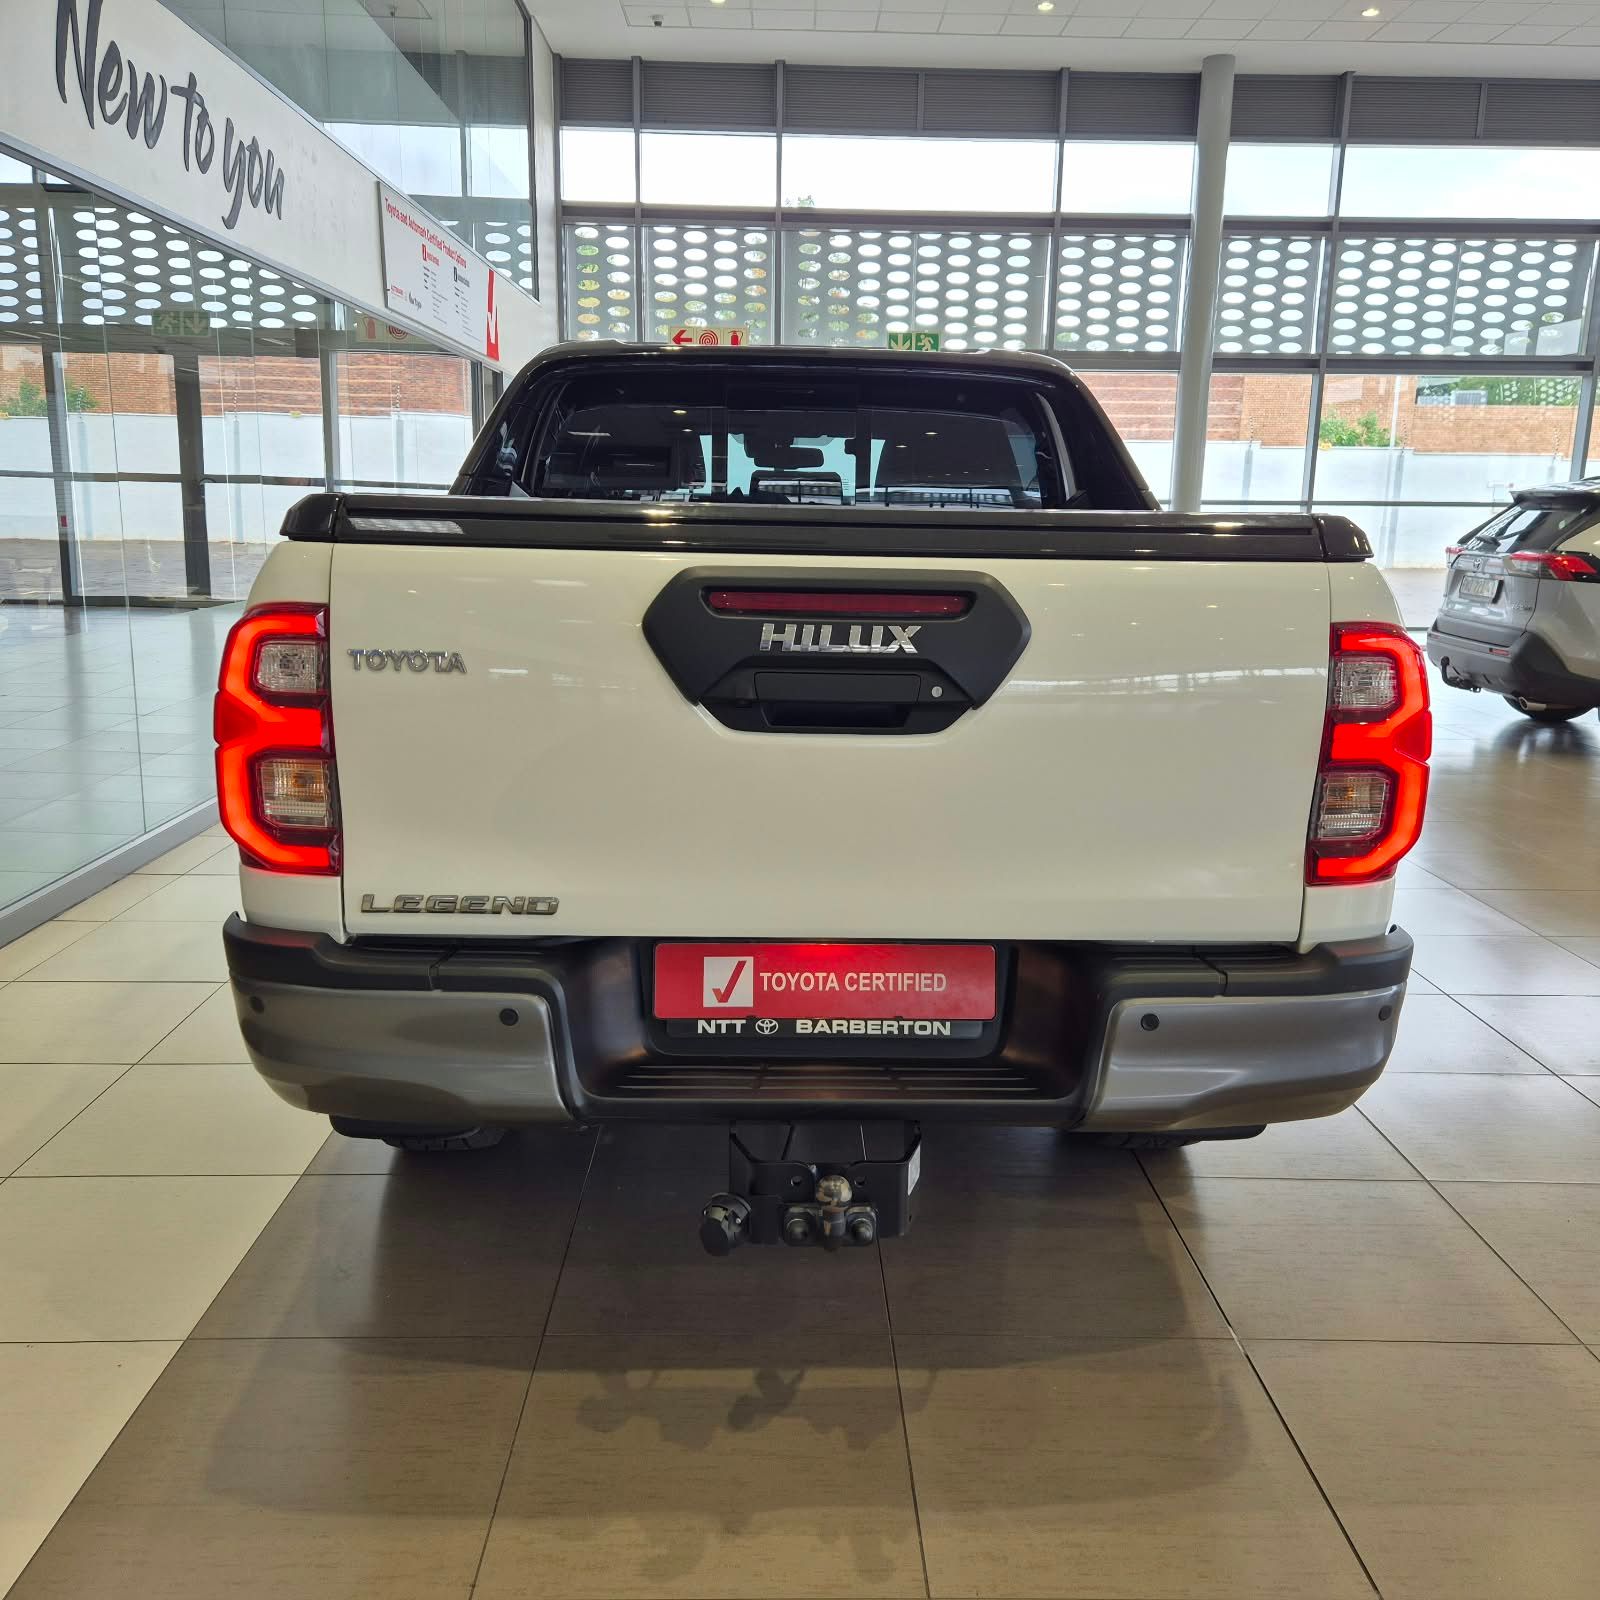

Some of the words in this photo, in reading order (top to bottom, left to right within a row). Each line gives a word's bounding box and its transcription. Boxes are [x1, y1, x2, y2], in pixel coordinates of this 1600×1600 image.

[56, 0, 167, 150] New
[170, 72, 215, 175] to
[221, 117, 285, 230] you
[385, 196, 400, 220] Toyota
[760, 623, 922, 654] HILUX
[347, 649, 467, 674] TOYOTA
[361, 894, 560, 915] LEGEND
[760, 972, 840, 992] TOYOTA
[844, 973, 947, 992] CERTIFIED
[697, 1019, 746, 1034] NTT
[795, 1019, 951, 1036] BARBERTON
